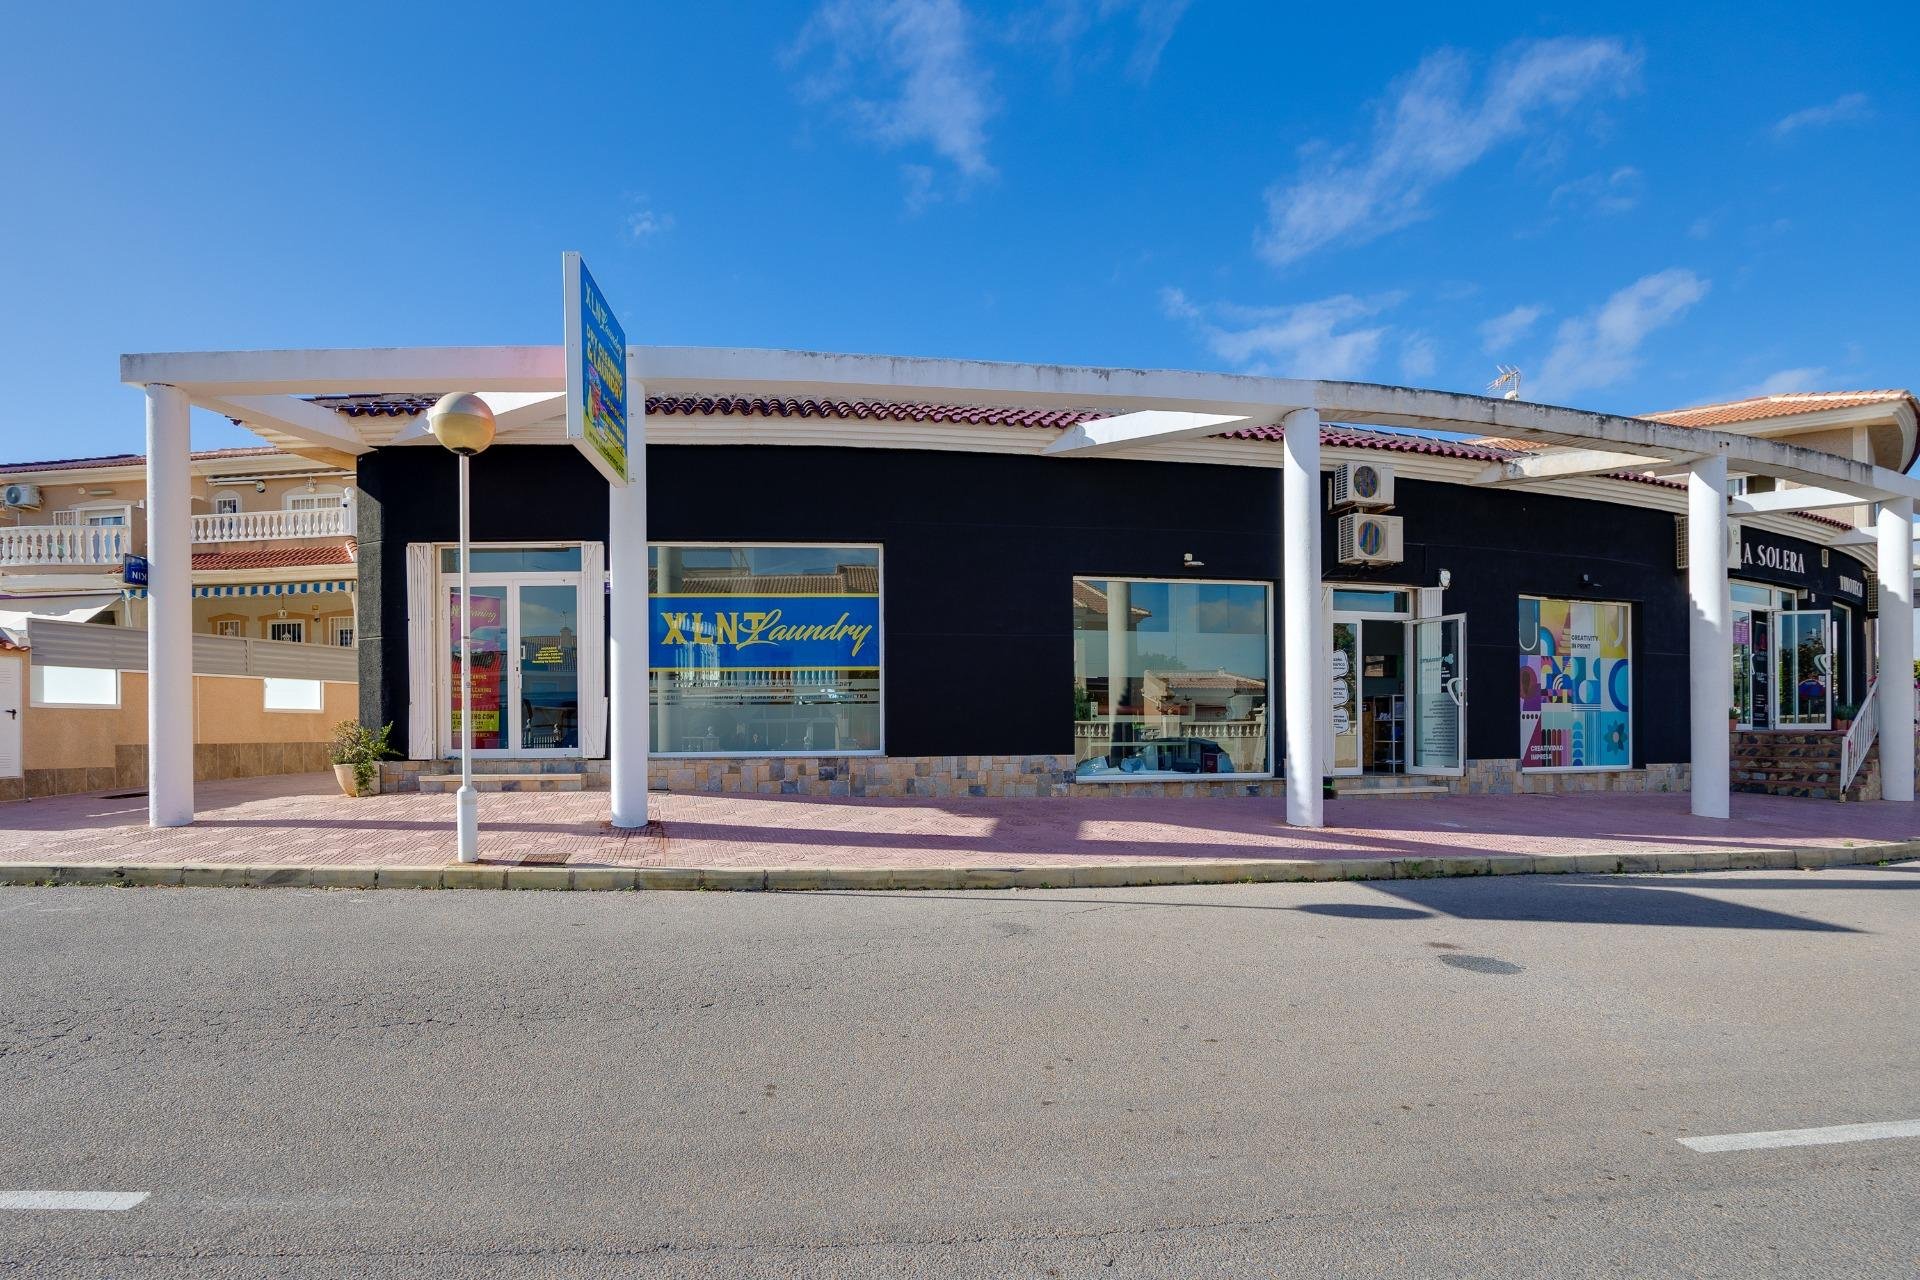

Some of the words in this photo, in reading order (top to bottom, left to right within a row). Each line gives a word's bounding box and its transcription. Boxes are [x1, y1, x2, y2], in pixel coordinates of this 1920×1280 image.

[1741, 543, 1753, 565] A
[1756, 545, 1805, 574] SOLERA
[660, 612, 766, 645] XLNT
[736, 608, 872, 657] Laundry
